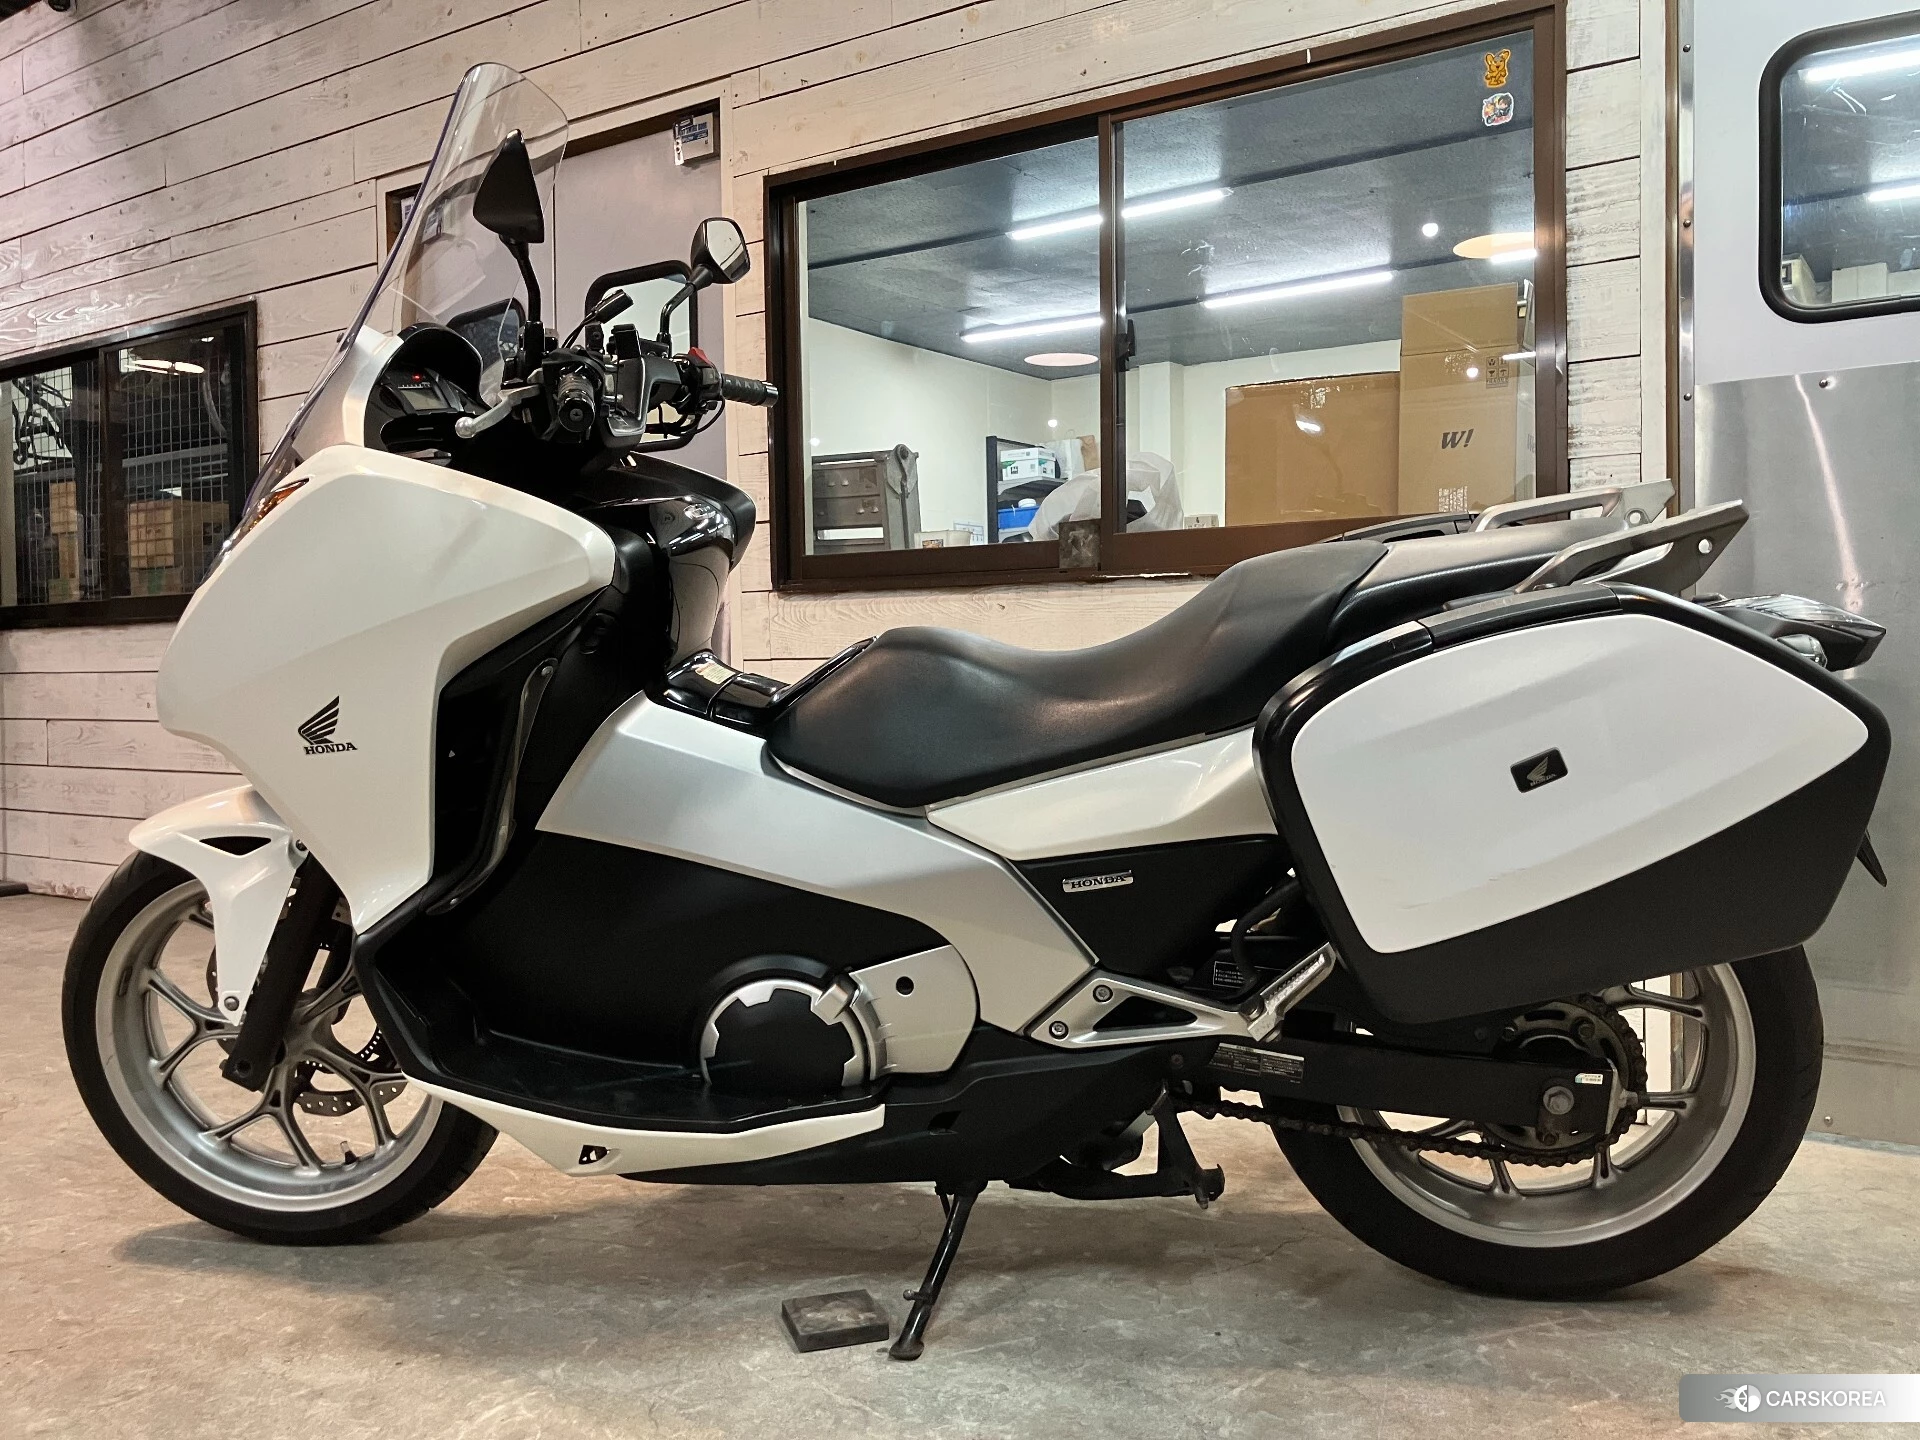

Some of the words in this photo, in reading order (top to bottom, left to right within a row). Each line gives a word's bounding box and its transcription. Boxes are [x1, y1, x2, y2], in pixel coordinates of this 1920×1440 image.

[1441, 428, 1475, 450] W!
[303, 742, 358, 755] HONDA
[1070, 875, 1127, 889] HONDA
